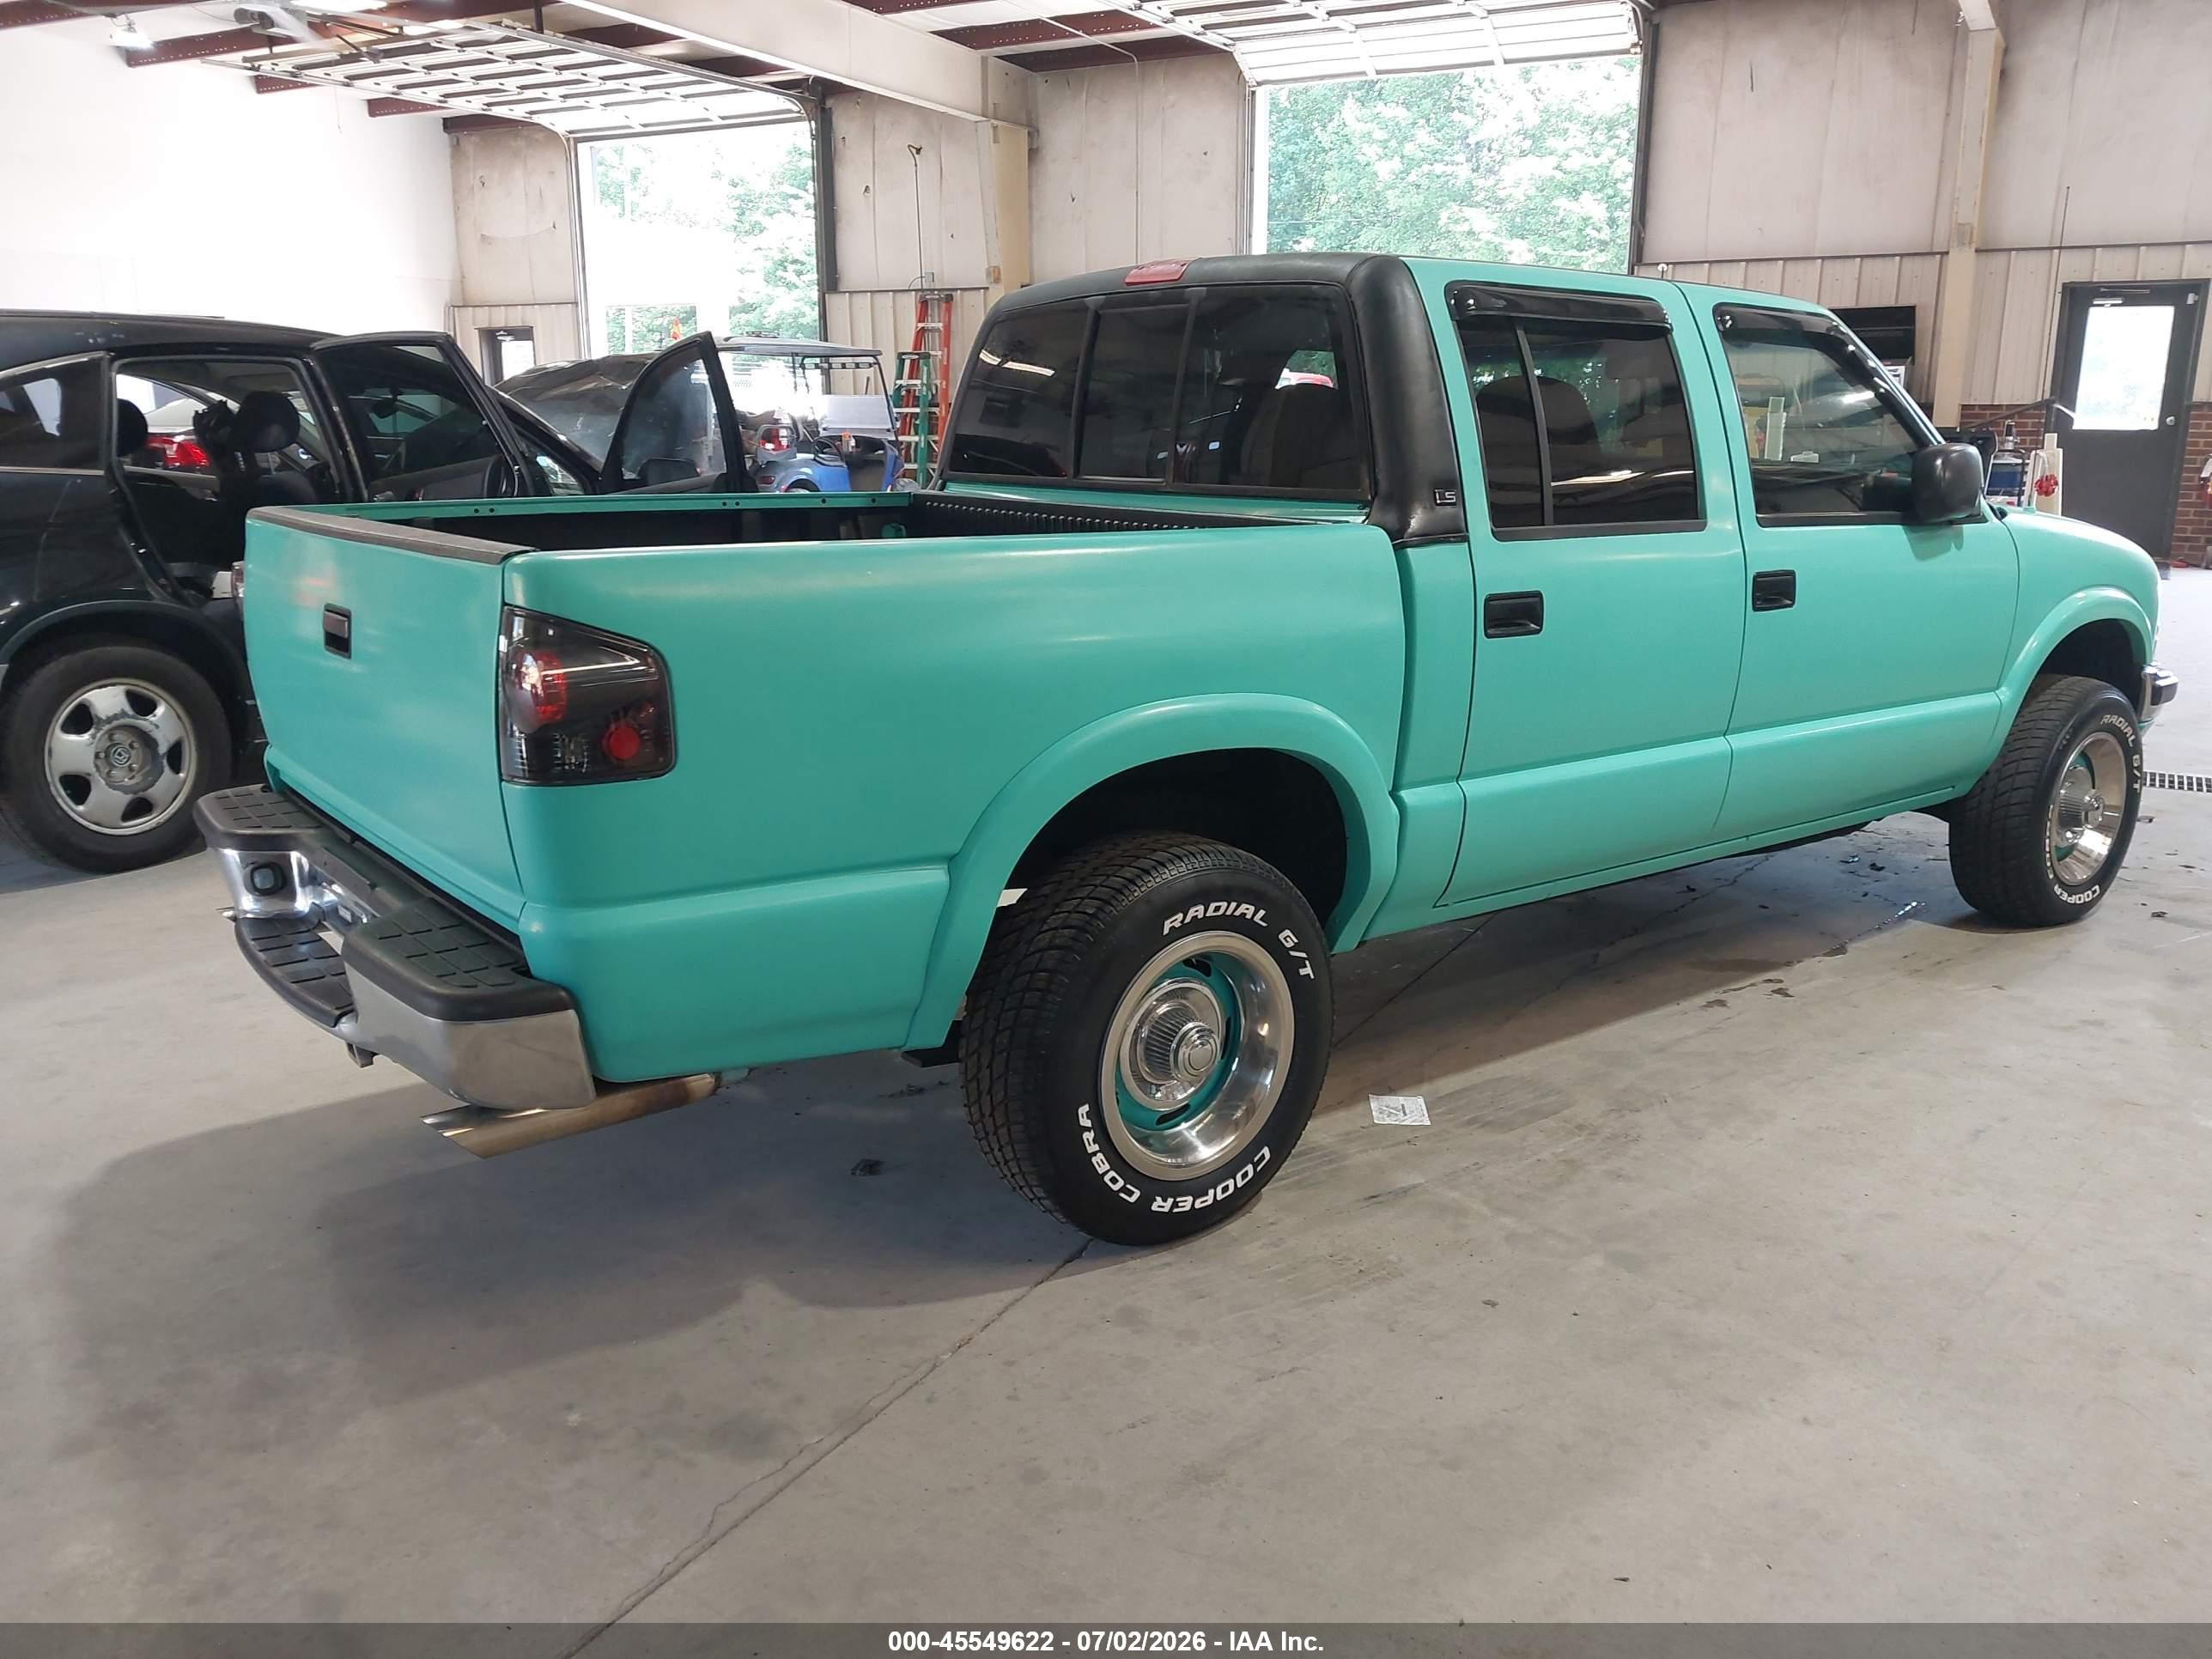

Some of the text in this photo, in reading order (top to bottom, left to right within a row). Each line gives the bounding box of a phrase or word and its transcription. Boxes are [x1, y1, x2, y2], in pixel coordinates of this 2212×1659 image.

[1435, 491, 1456, 503] LS
[2100, 714, 2136, 747] RADIAL
[2054, 884, 2100, 904] COOPER
[1162, 901, 1316, 981] RADIAL G/T
[1075, 1103, 1272, 1213] COOPER COBRA
